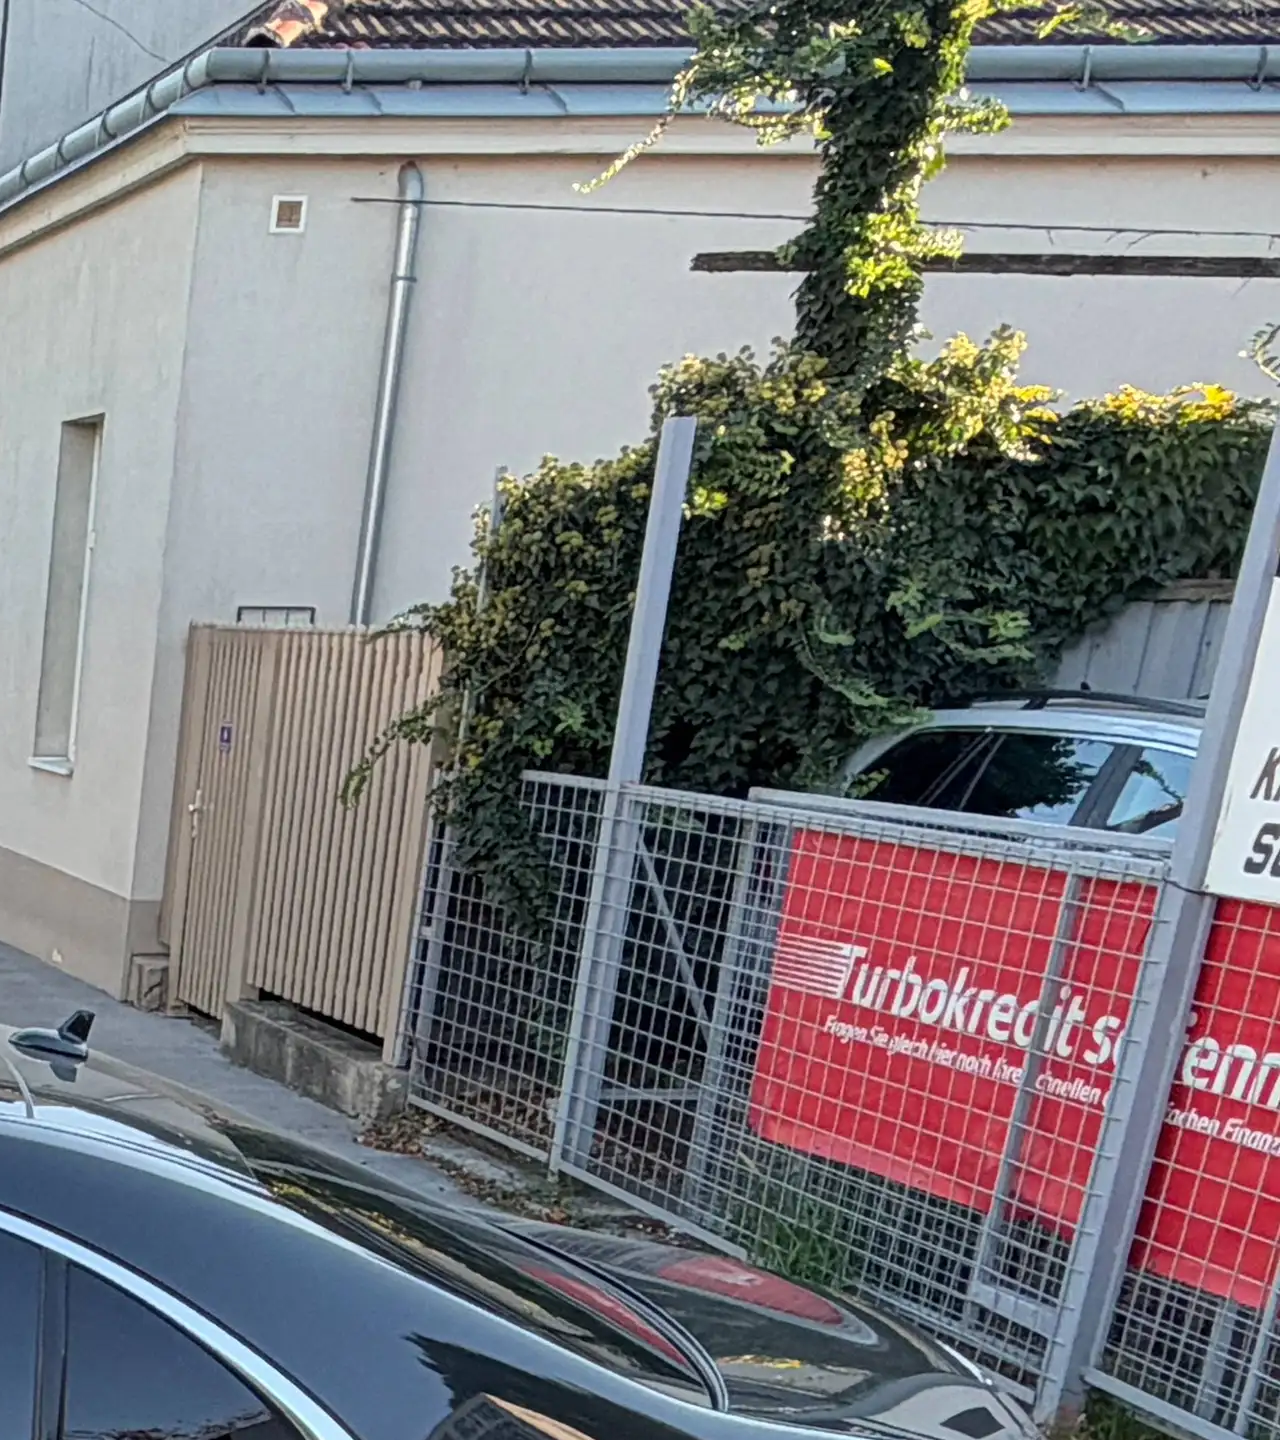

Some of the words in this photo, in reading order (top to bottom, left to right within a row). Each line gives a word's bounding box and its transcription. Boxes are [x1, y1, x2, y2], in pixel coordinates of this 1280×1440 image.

[1248, 746, 1280, 801] K
[823, 1014, 868, 1044] Fragen
[1035, 1070, 1102, 1105] chnellen
